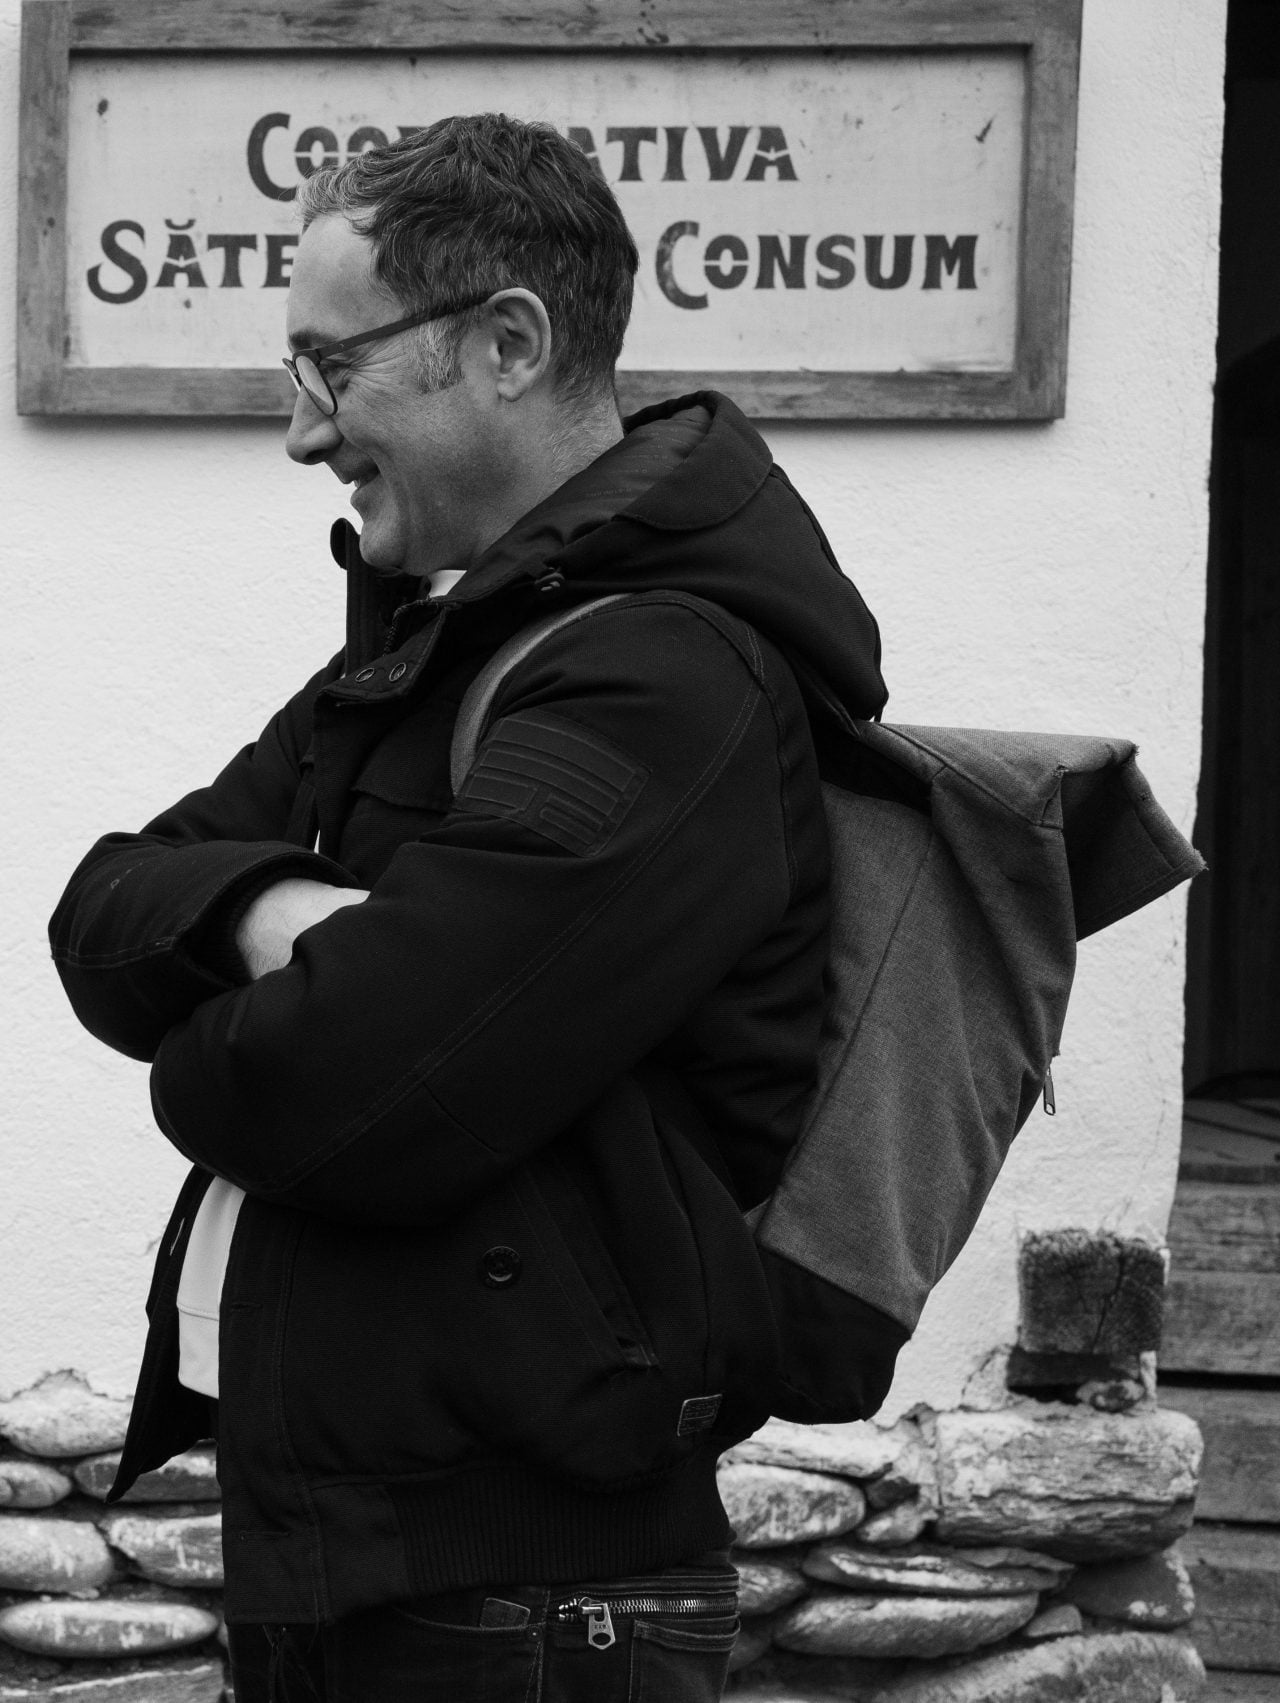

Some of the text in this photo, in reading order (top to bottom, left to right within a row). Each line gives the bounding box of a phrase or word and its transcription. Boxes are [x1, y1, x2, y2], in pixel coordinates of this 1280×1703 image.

[247, 112, 798, 202] COOTIVA
[87, 218, 978, 310] SĂTE CONSUM
